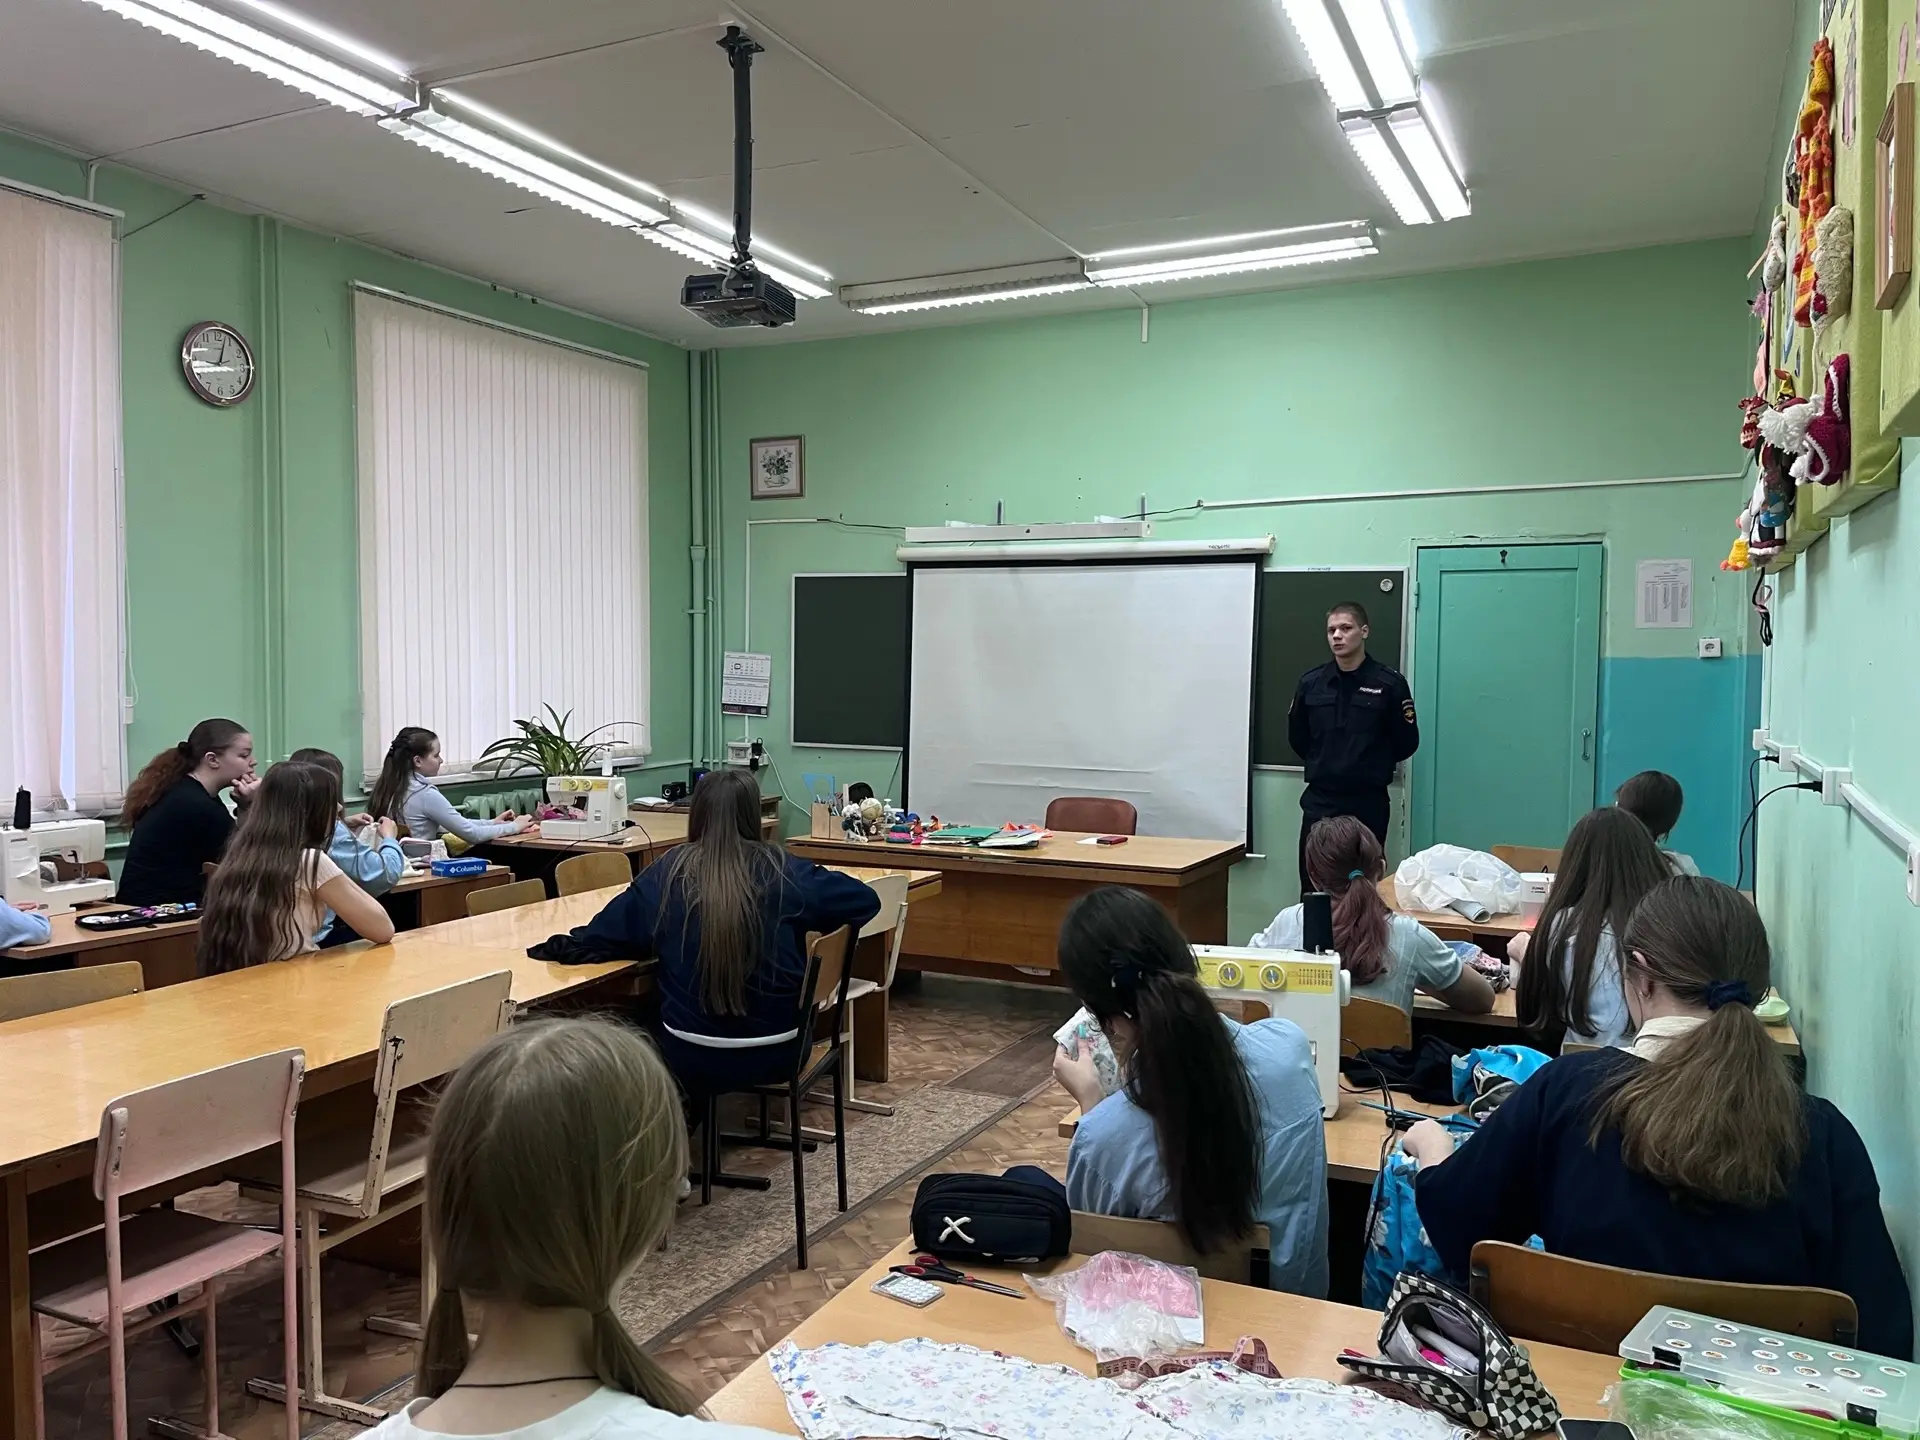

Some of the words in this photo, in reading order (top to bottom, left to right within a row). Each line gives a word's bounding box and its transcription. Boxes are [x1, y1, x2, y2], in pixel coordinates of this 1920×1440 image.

[202, 332, 210, 343] 11
[214, 331, 223, 342] 12
[235, 348, 242, 359] 2
[239, 363, 246, 373] 3
[206, 381, 212, 392] 7
[236, 376, 243, 386] 4
[217, 387, 224, 396] 6
[229, 384, 236, 395] 5
[455, 864, 483, 873] Columbia
